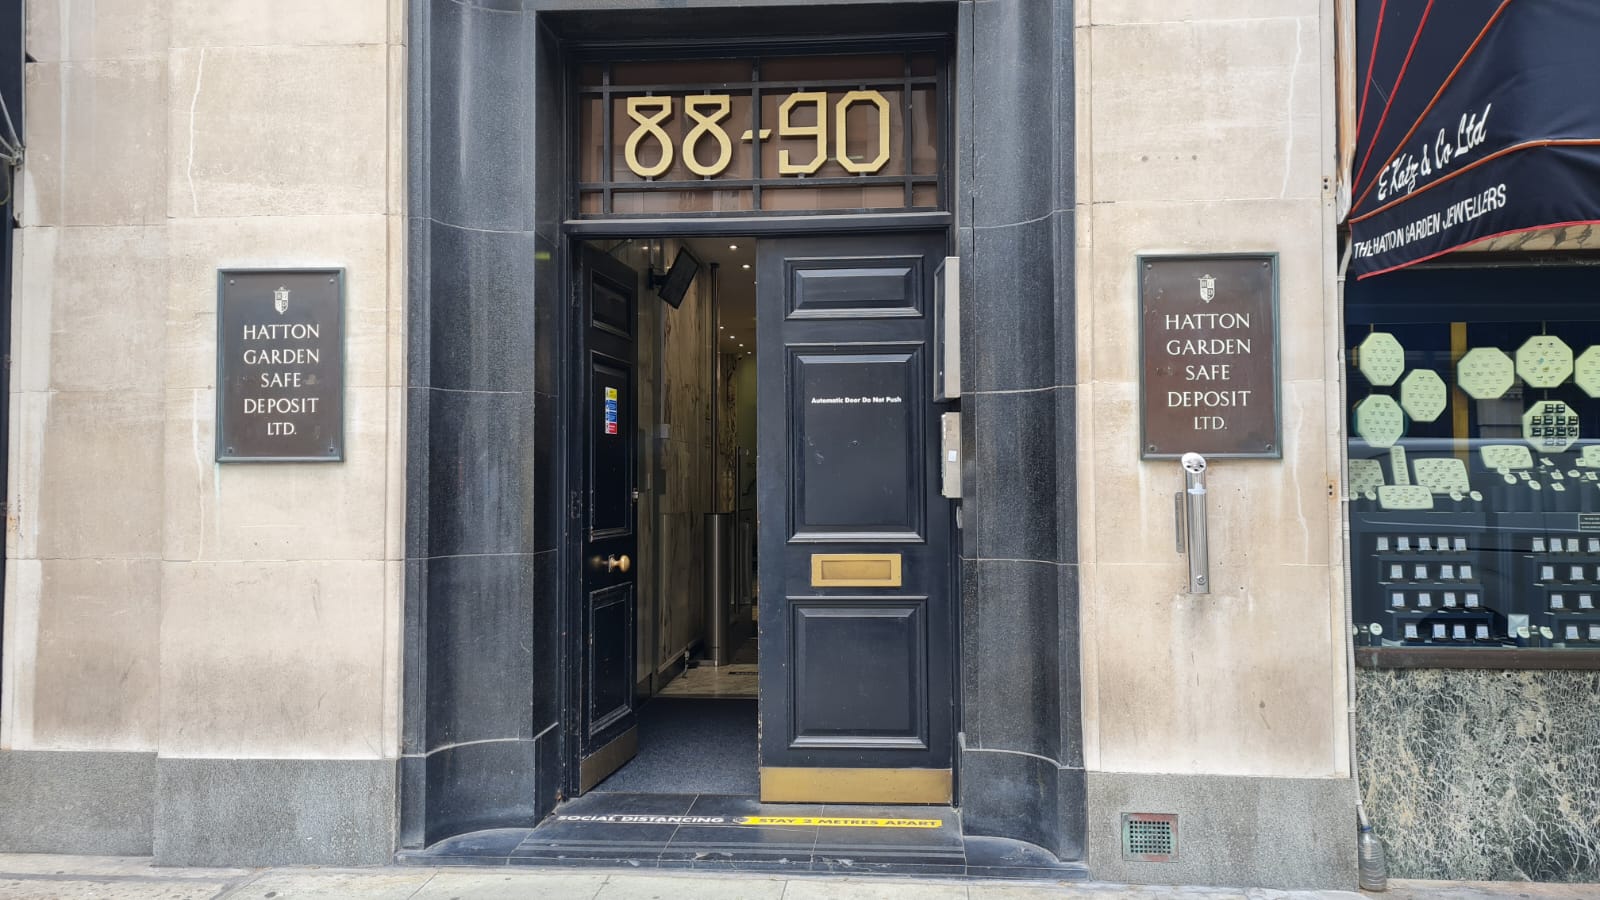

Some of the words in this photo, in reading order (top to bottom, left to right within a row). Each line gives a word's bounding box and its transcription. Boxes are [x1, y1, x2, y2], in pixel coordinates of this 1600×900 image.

[624, 90, 890, 177] 88-90
[1378, 165, 1390, 201] E
[1390, 153, 1419, 195] Katz
[1421, 144, 1432, 176] &
[1435, 128, 1453, 169] Co
[1454, 103, 1492, 158] Ltd
[1354, 239, 1374, 259] THE
[1405, 212, 1441, 244] GARDEN
[1442, 184, 1507, 229] JEWELLERS
[1165, 313, 1250, 330] HATTON
[243, 323, 320, 340] HATTON
[1166, 339, 1251, 355] GARDEN
[243, 349, 320, 365] GARDEN
[261, 372, 301, 388] SAFE
[1185, 365, 1230, 381] SAFE
[243, 398, 319, 414] DEPOSIT
[1168, 390, 1251, 407] DEPOSIT
[267, 422, 297, 436] LTD.
[1194, 416, 1228, 430] LTD.
[556, 814, 615, 822] SOCIAL
[621, 815, 724, 824] DISTANCING
[818, 818, 879, 826] METRES
[885, 819, 937, 827] APART
